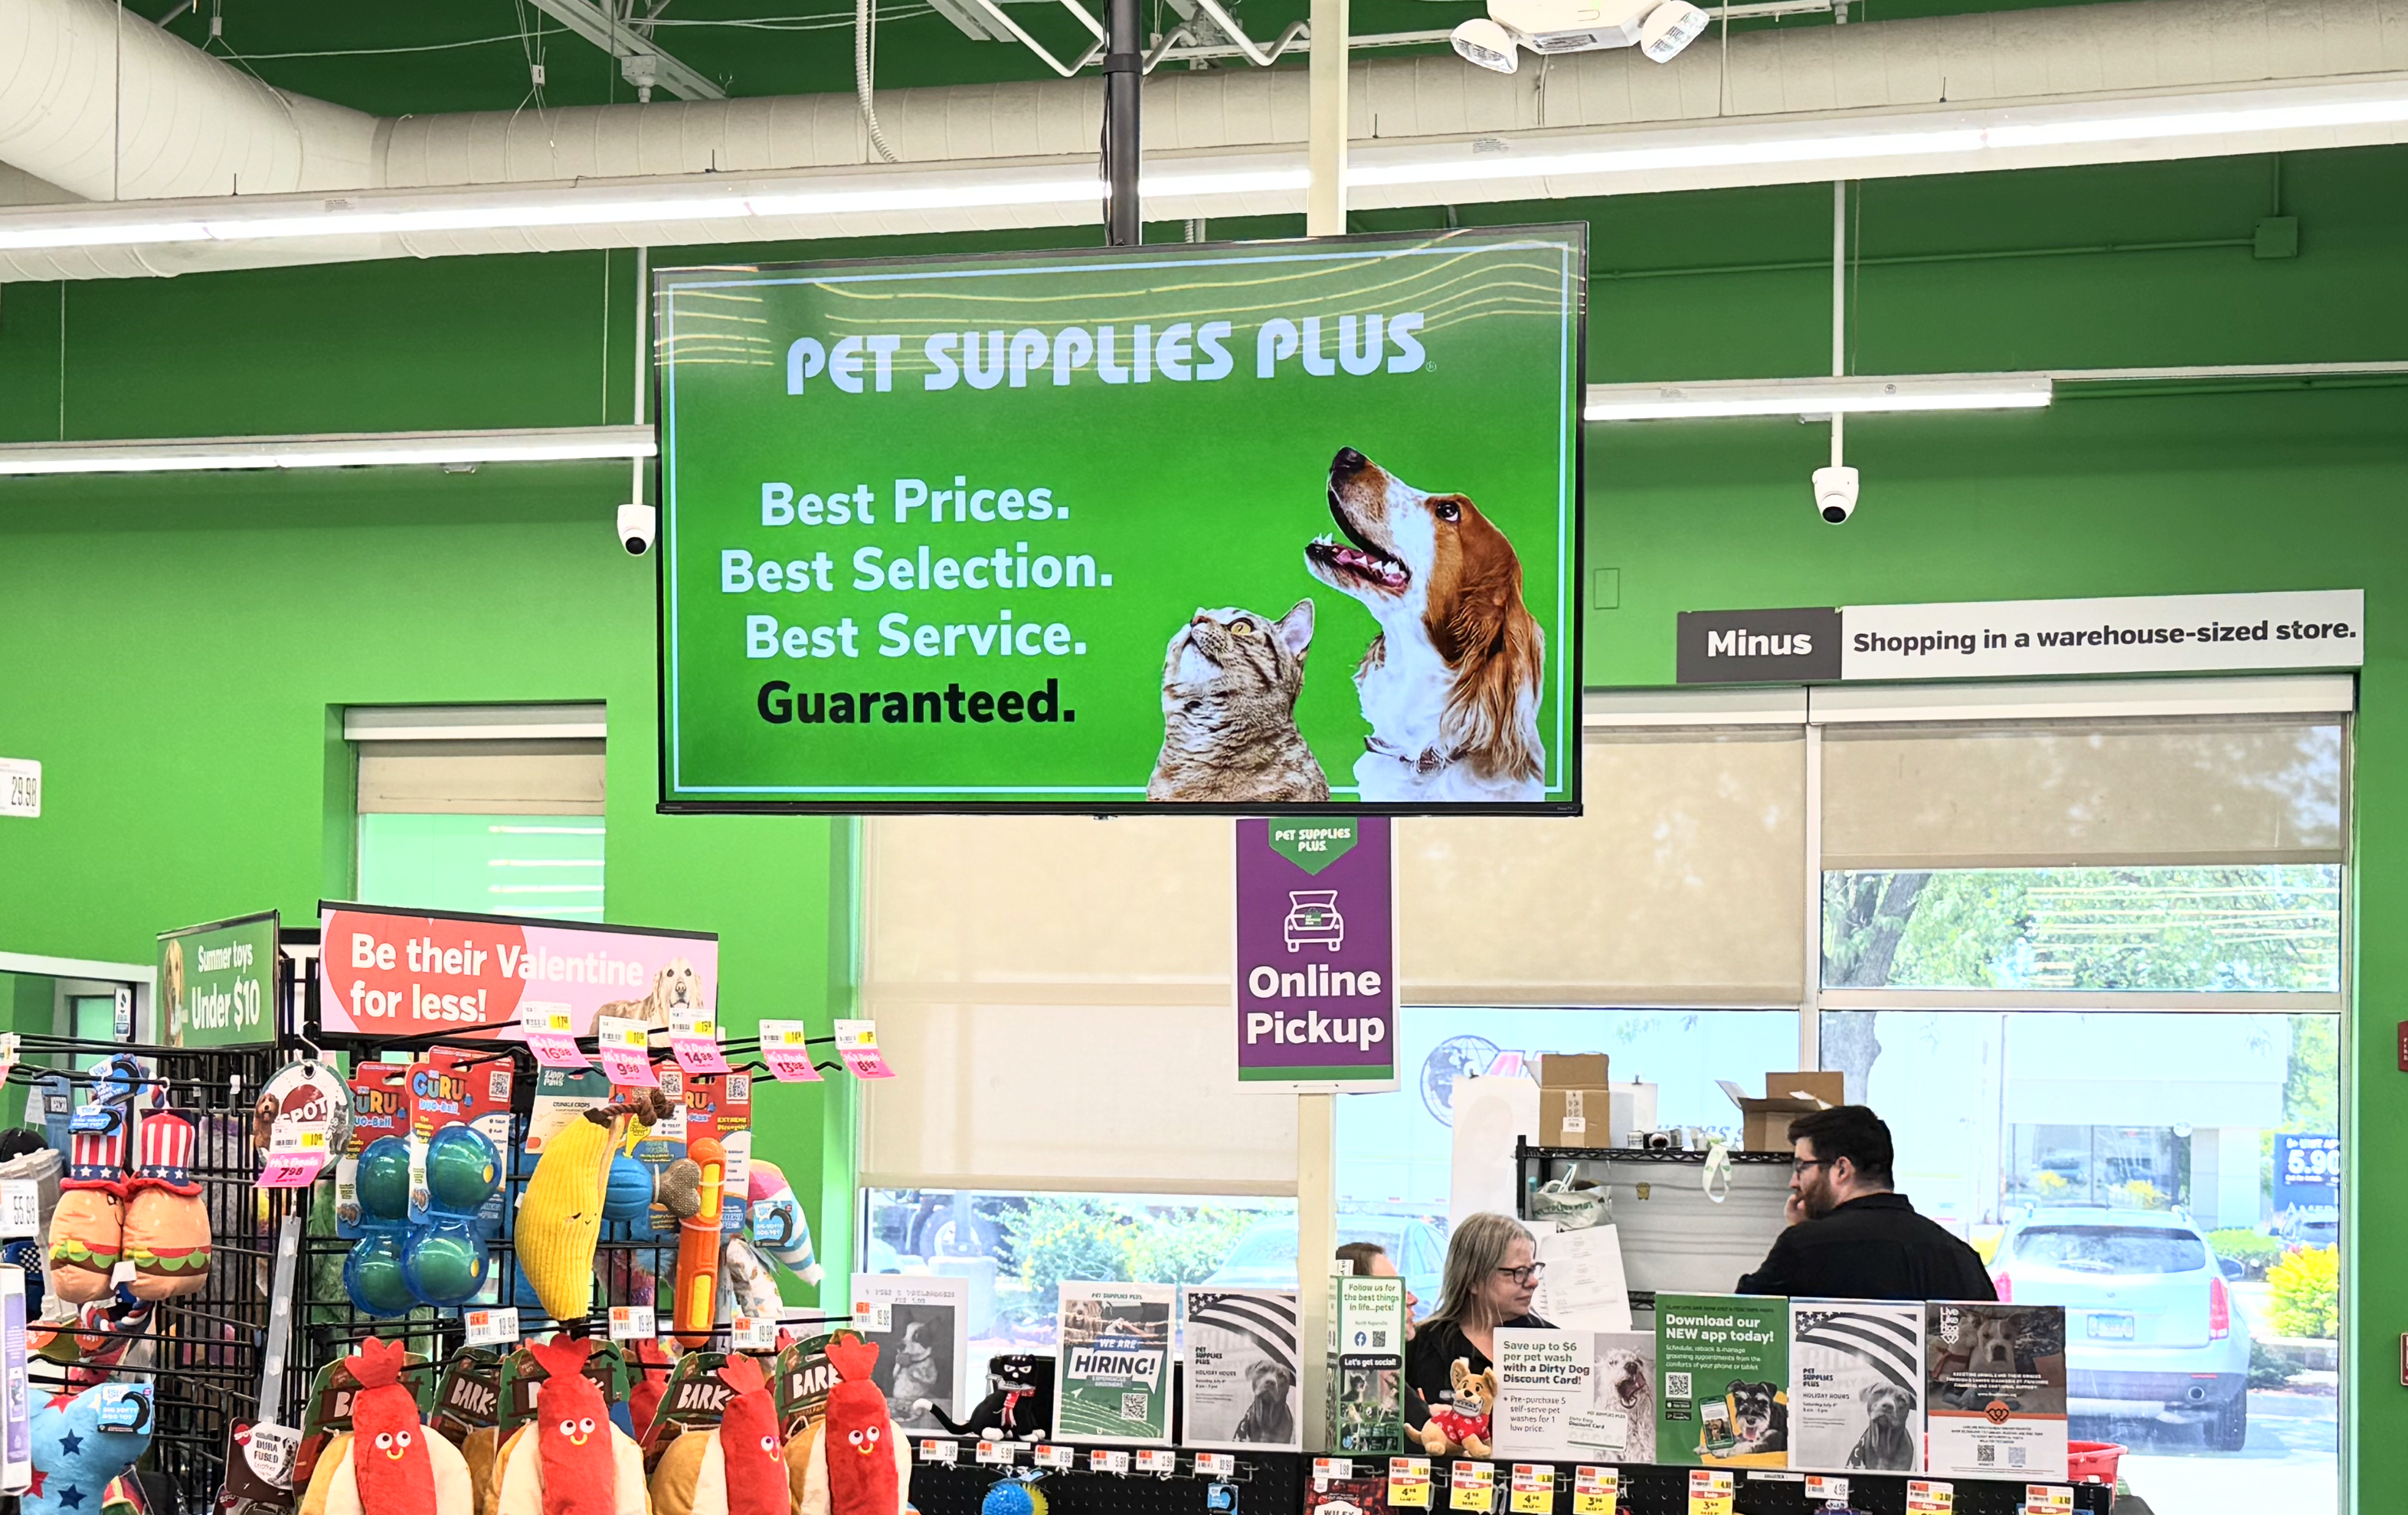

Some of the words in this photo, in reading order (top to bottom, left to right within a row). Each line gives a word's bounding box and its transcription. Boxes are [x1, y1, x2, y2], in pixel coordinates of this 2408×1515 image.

[787, 332, 893, 396] PET
[924, 320, 1232, 391] SUPPLIES
[1257, 309, 1427, 378] PLUS
[762, 481, 875, 525] Best
[895, 475, 1069, 522] Prices.
[721, 549, 833, 593] Best
[852, 542, 1112, 591] Selection.
[747, 614, 859, 658] Best
[878, 610, 1087, 657] Service.
[1706, 629, 1812, 657] Minus
[1853, 630, 1976, 657] Shopping
[1982, 627, 2007, 650] in
[2014, 631, 2030, 650] a
[2037, 619, 2269, 649] warehouse-sized
[2276, 619, 2357, 640] store.
[757, 678, 1075, 724] Guaranteed.
[11, 776, 38, 807] 29.98
[1275, 829, 1296, 841] PET
[1299, 828, 1351, 840] SUPPLIES
[1298, 841, 1327, 852] PLUS
[198, 944, 232, 973] Summer
[233, 940, 254, 973] toys
[351, 932, 395, 971] Be
[407, 934, 487, 977] their
[498, 944, 644, 987] Valentine
[1248, 964, 1382, 999] Online
[191, 982, 231, 1030] Under
[234, 975, 260, 1032] $10
[350, 986, 401, 1017] for
[411, 987, 487, 1023] less!
[1247, 1010, 1385, 1051] Pickup
[412, 1071, 466, 1101] GURU
[355, 1090, 398, 1114] URU
[1344, 1293, 1357, 1301] the
[1358, 1293, 1375, 1301] best
[1376, 1293, 1400, 1303] things
[1349, 1283, 1373, 1291] Follow
[1350, 1303, 1356, 1311] in
[1666, 1313, 1733, 1327] Download
[1736, 1318, 1761, 1328] our
[1099, 1338, 1116, 1348] WE
[1117, 1340, 1138, 1349] ARE
[1503, 1340, 1530, 1351] Save
[1532, 1343, 1546, 1353] up
[1549, 1343, 1559, 1351] to
[1562, 1342, 1577, 1352] $6
[1666, 1327, 1698, 1340] NEW
[1701, 1330, 1727, 1343] app
[1730, 1330, 1774, 1345] today!
[1075, 1354, 1156, 1376] HIRING!
[1344, 1358, 1361, 1366] Let's
[1362, 1359, 1373, 1368] get
[1503, 1353, 1522, 1363] per
[1523, 1353, 1541, 1363] pet
[1544, 1353, 1572, 1363] wash
[1503, 1363, 1527, 1373] with
[1539, 1363, 1566, 1376] Dirty
[1569, 1365, 1591, 1376] Dog
[1503, 1373, 1550, 1384] Discount
[1553, 1375, 1582, 1385] Card!
[793, 1363, 843, 1399] BARK
[450, 1376, 494, 1416] BARK
[677, 1382, 727, 1411] BARK
[1510, 1396, 1559, 1406] Pre-purchase
[1510, 1405, 1547, 1414] self-serve
[1510, 1415, 1537, 1423] washes
[1524, 1425, 1545, 1433] price.
[254, 1450, 279, 1464] FUSED
[256, 1440, 278, 1453] DURA
